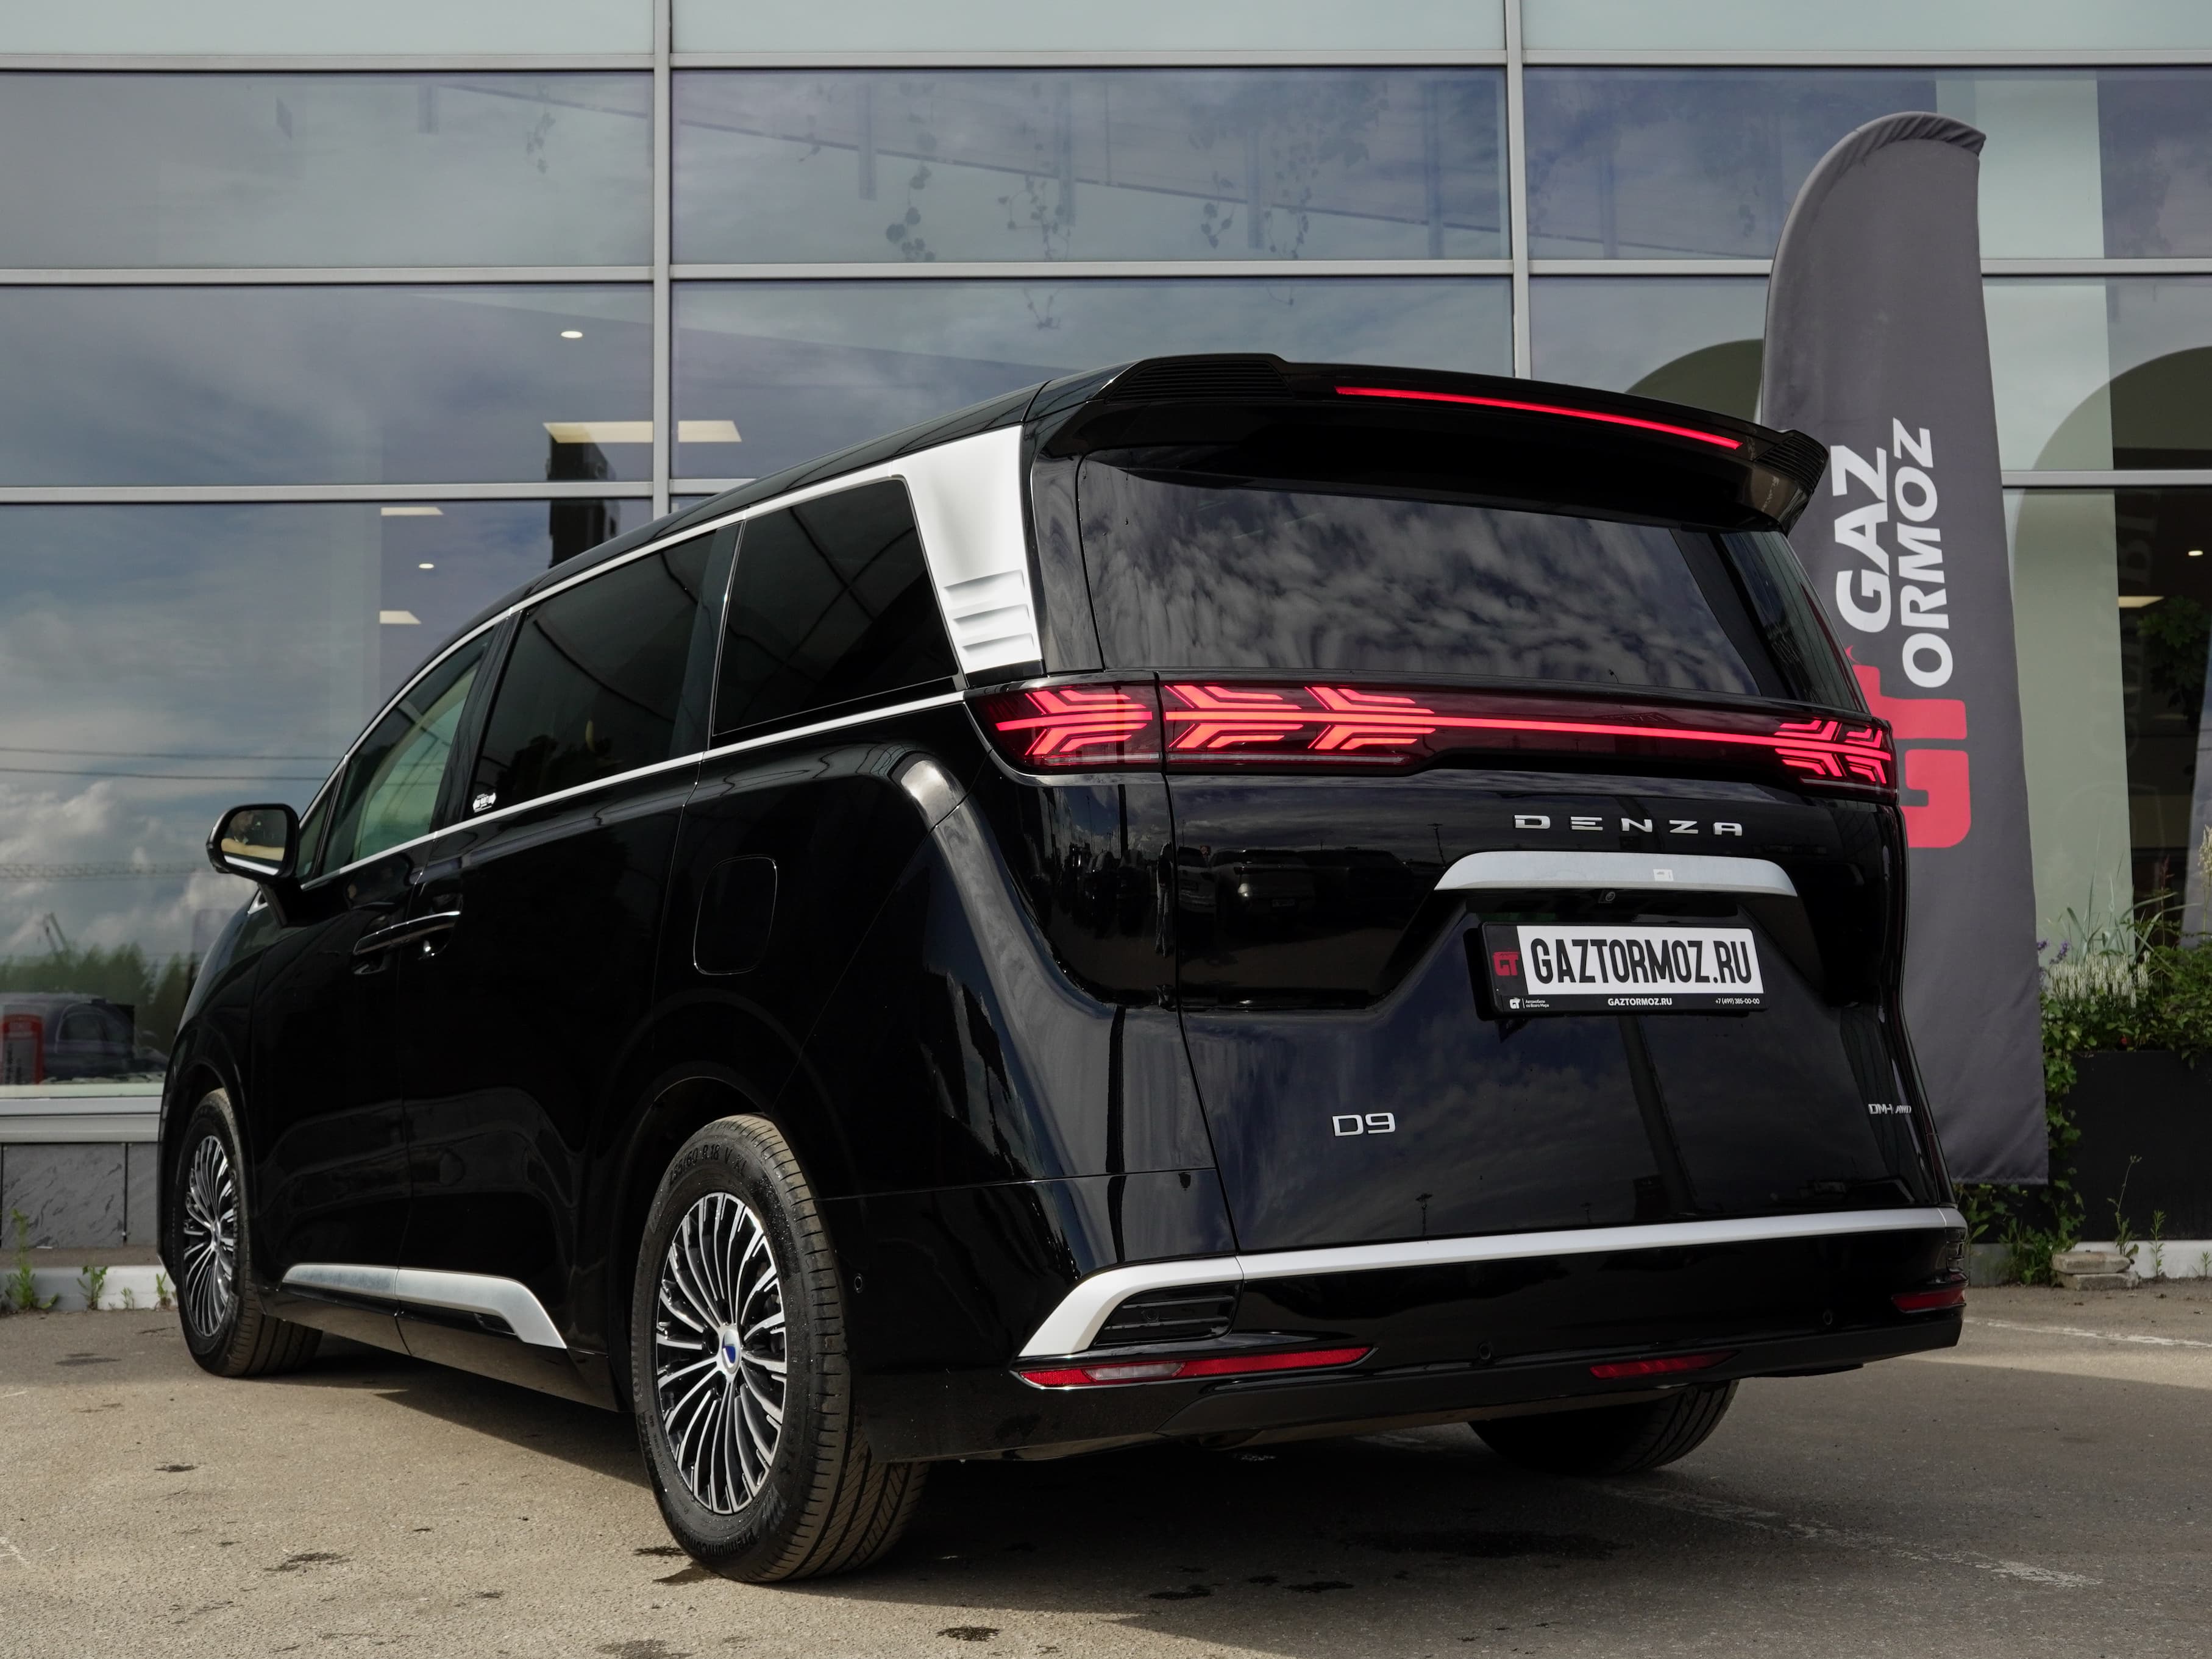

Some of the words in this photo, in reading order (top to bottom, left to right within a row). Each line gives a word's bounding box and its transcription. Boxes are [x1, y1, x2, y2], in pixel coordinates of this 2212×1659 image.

[1829, 445, 1891, 633] GAZ
[1892, 417, 1953, 689] ORMOZ
[1513, 813, 1743, 837] DENZA
[1530, 938, 1752, 984] GAZTORMOZ.RU
[1607, 998, 1673, 1006] GAZTORMOZ.RU
[1895, 1105, 1912, 1114] AWD
[1332, 1112, 1396, 1137] D9
